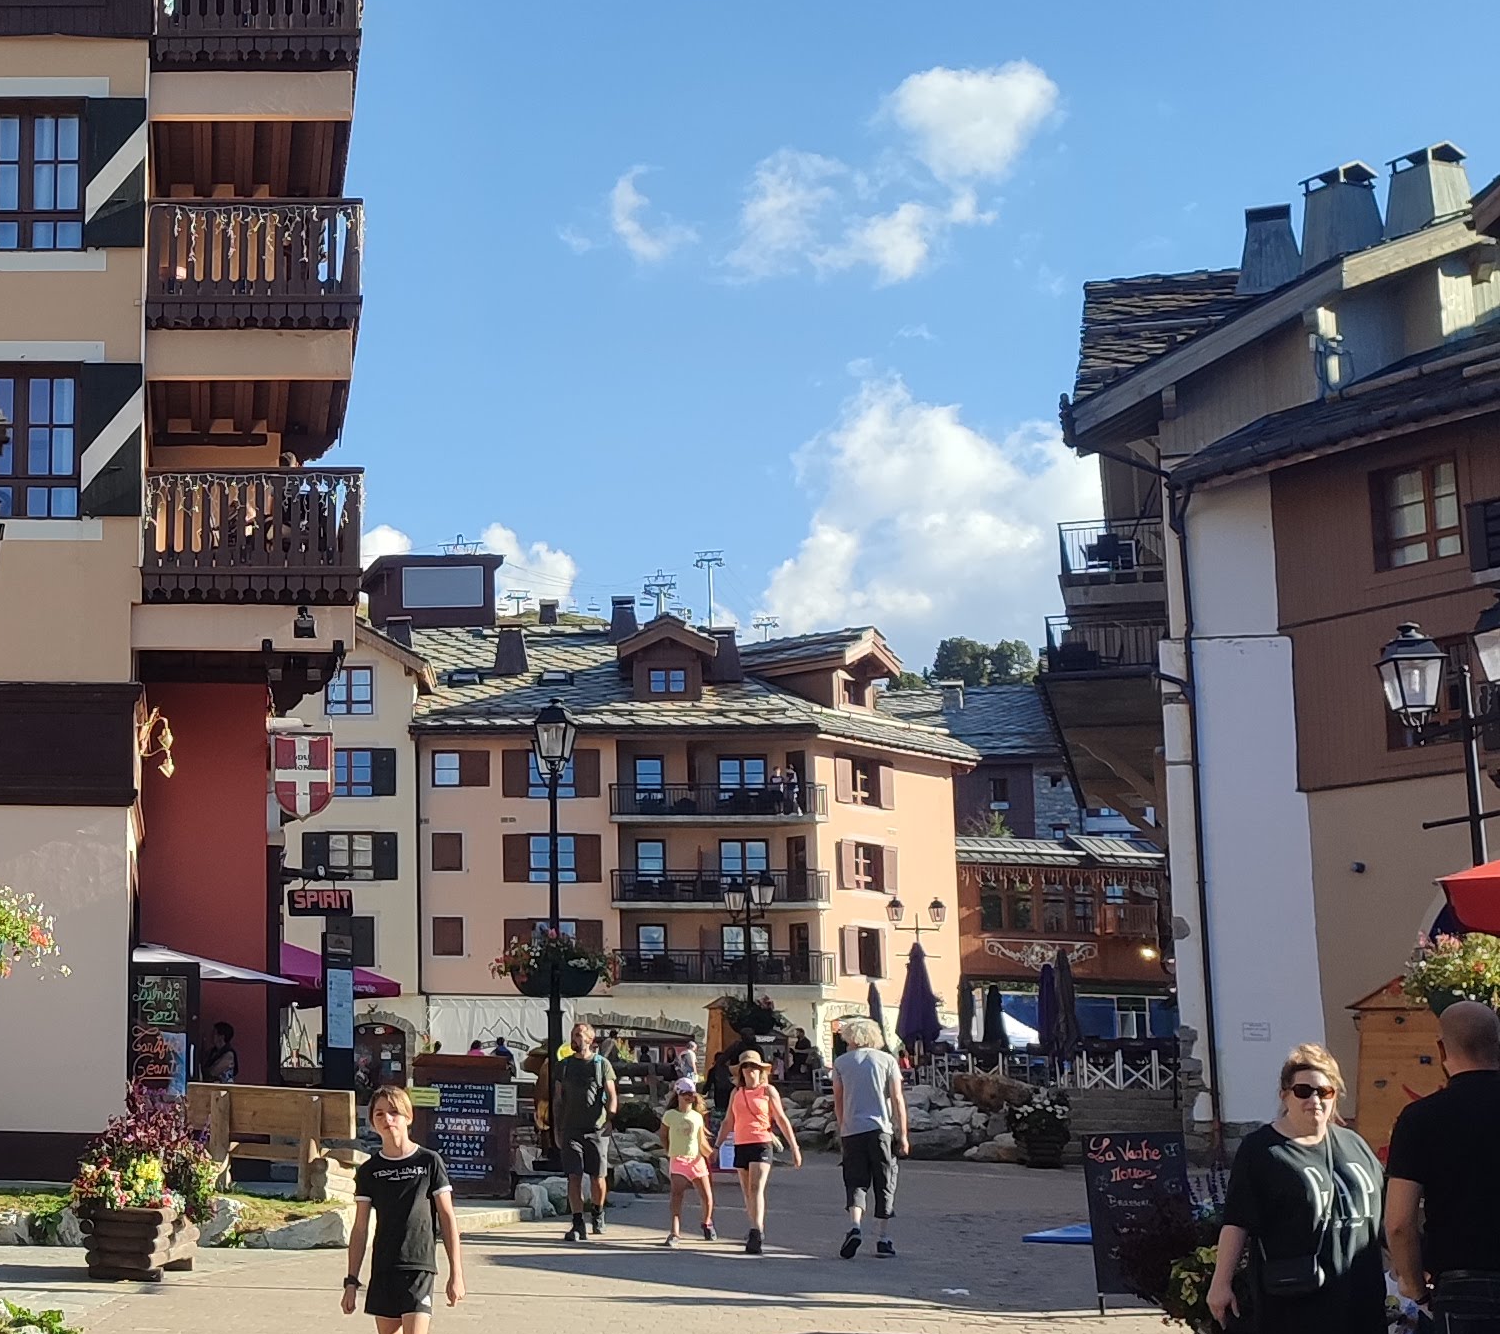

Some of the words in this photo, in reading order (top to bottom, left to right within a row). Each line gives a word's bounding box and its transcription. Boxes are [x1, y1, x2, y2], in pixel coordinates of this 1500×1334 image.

[293, 890, 350, 909] SPIRIT
[1087, 1137, 1116, 1163] La
[1117, 1139, 1162, 1162] Vache
[1303, 1162, 1375, 1221] GAP
